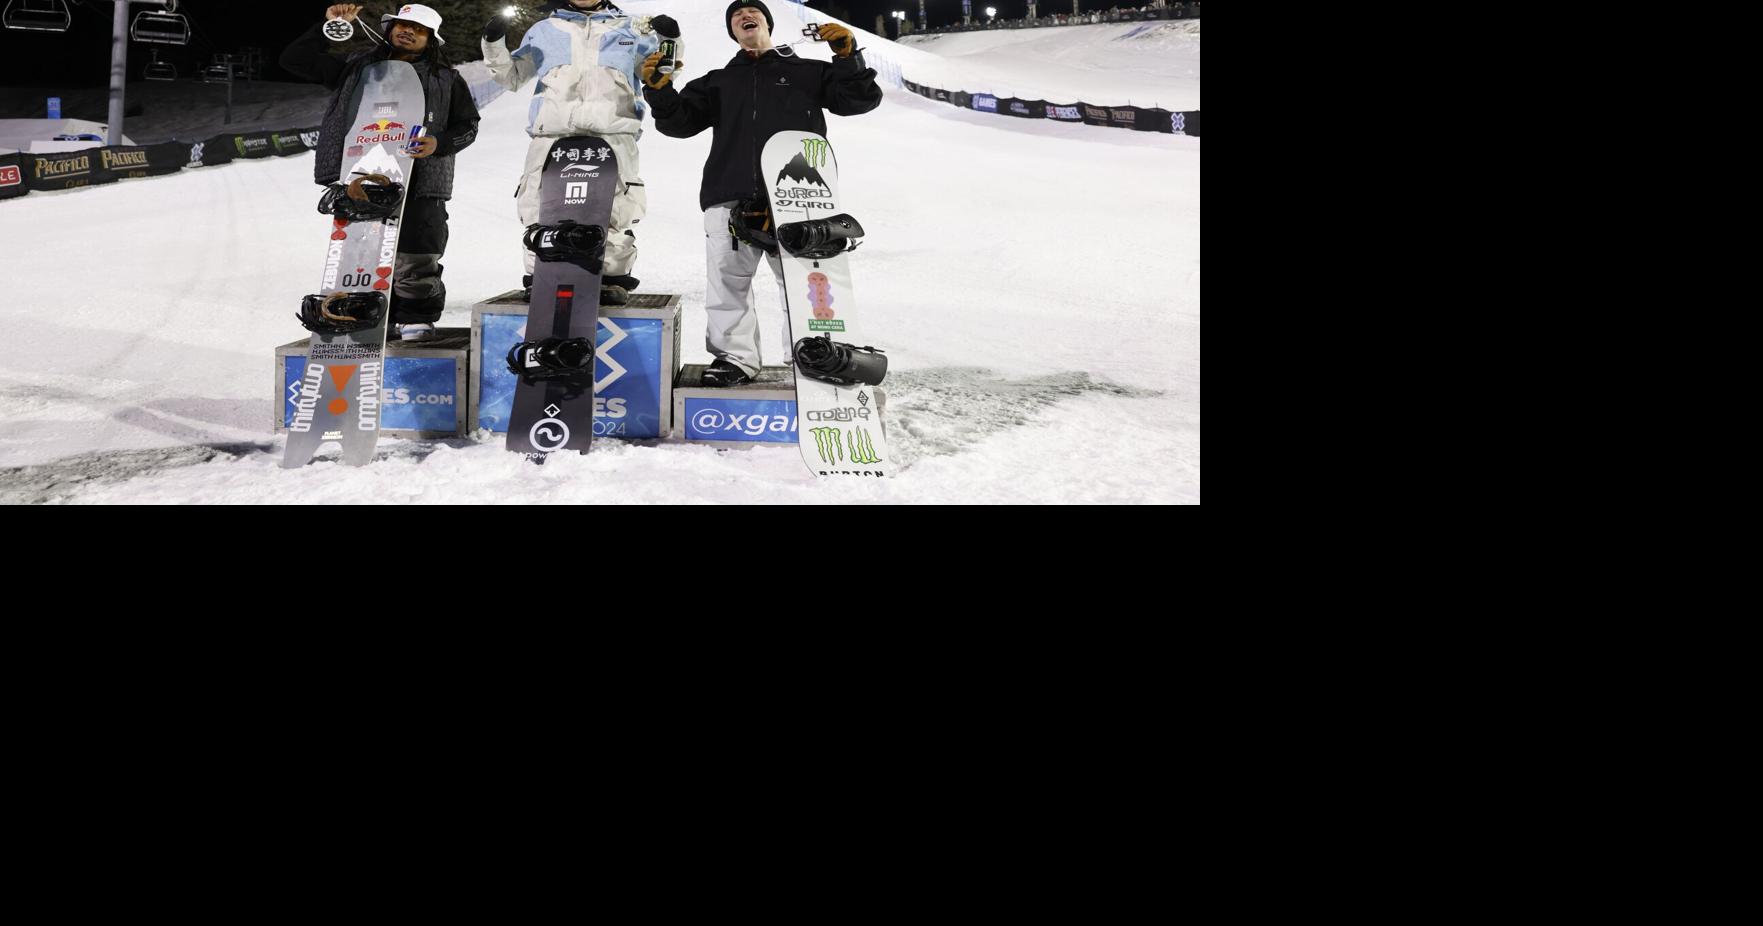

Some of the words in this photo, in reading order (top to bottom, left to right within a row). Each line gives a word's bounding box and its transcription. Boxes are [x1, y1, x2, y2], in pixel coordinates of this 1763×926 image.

[356, 134, 380, 144] Red
[381, 132, 405, 142] Bull
[34, 155, 90, 179] PACIFICO
[101, 150, 148, 169] PACIFICO
[0, 170, 16, 181] LE
[795, 201, 834, 210] GIRO
[290, 363, 325, 432] thirtytwo
[356, 362, 380, 430] thirtytwo
[383, 388, 453, 404] ES.COM
[593, 398, 627, 418] ES
[592, 421, 627, 435] 024
[691, 408, 798, 435] @xga
